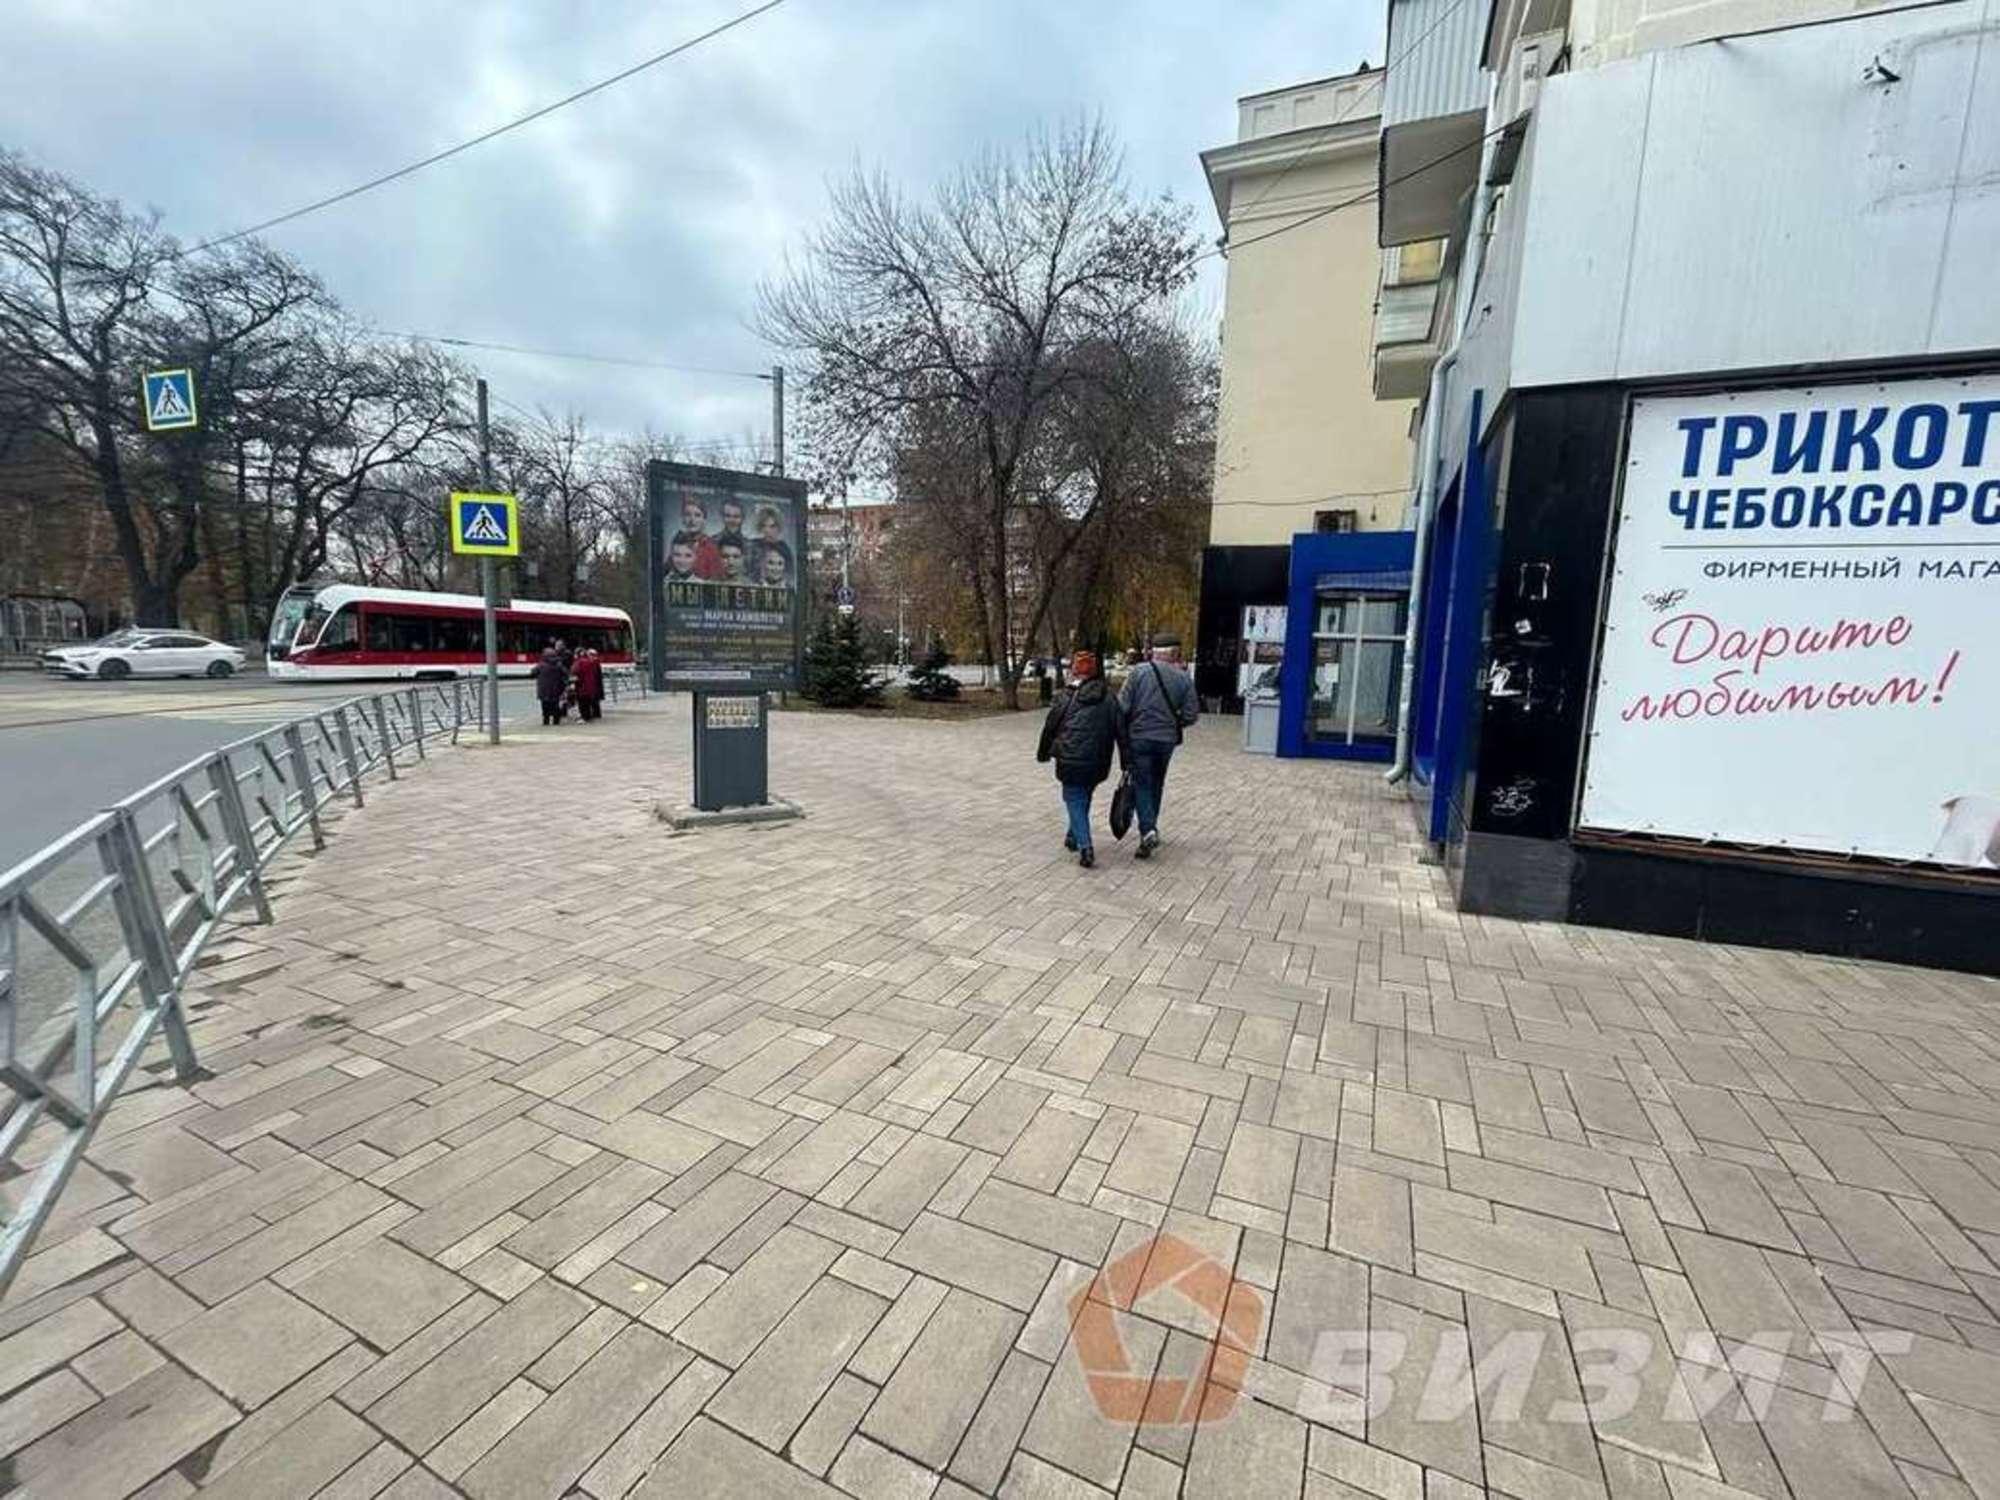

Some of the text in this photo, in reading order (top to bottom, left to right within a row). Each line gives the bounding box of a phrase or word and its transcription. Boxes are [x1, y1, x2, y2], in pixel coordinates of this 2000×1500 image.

[1678, 400, 2000, 477] ТРИКОТ
[1669, 480, 2000, 529] ЧЕБОКСАРС
[1703, 556, 2000, 578] ФИРМЕННЫЙ МАГА
[1651, 614, 1912, 674] Дарите
[1622, 650, 1959, 722] любимым!
